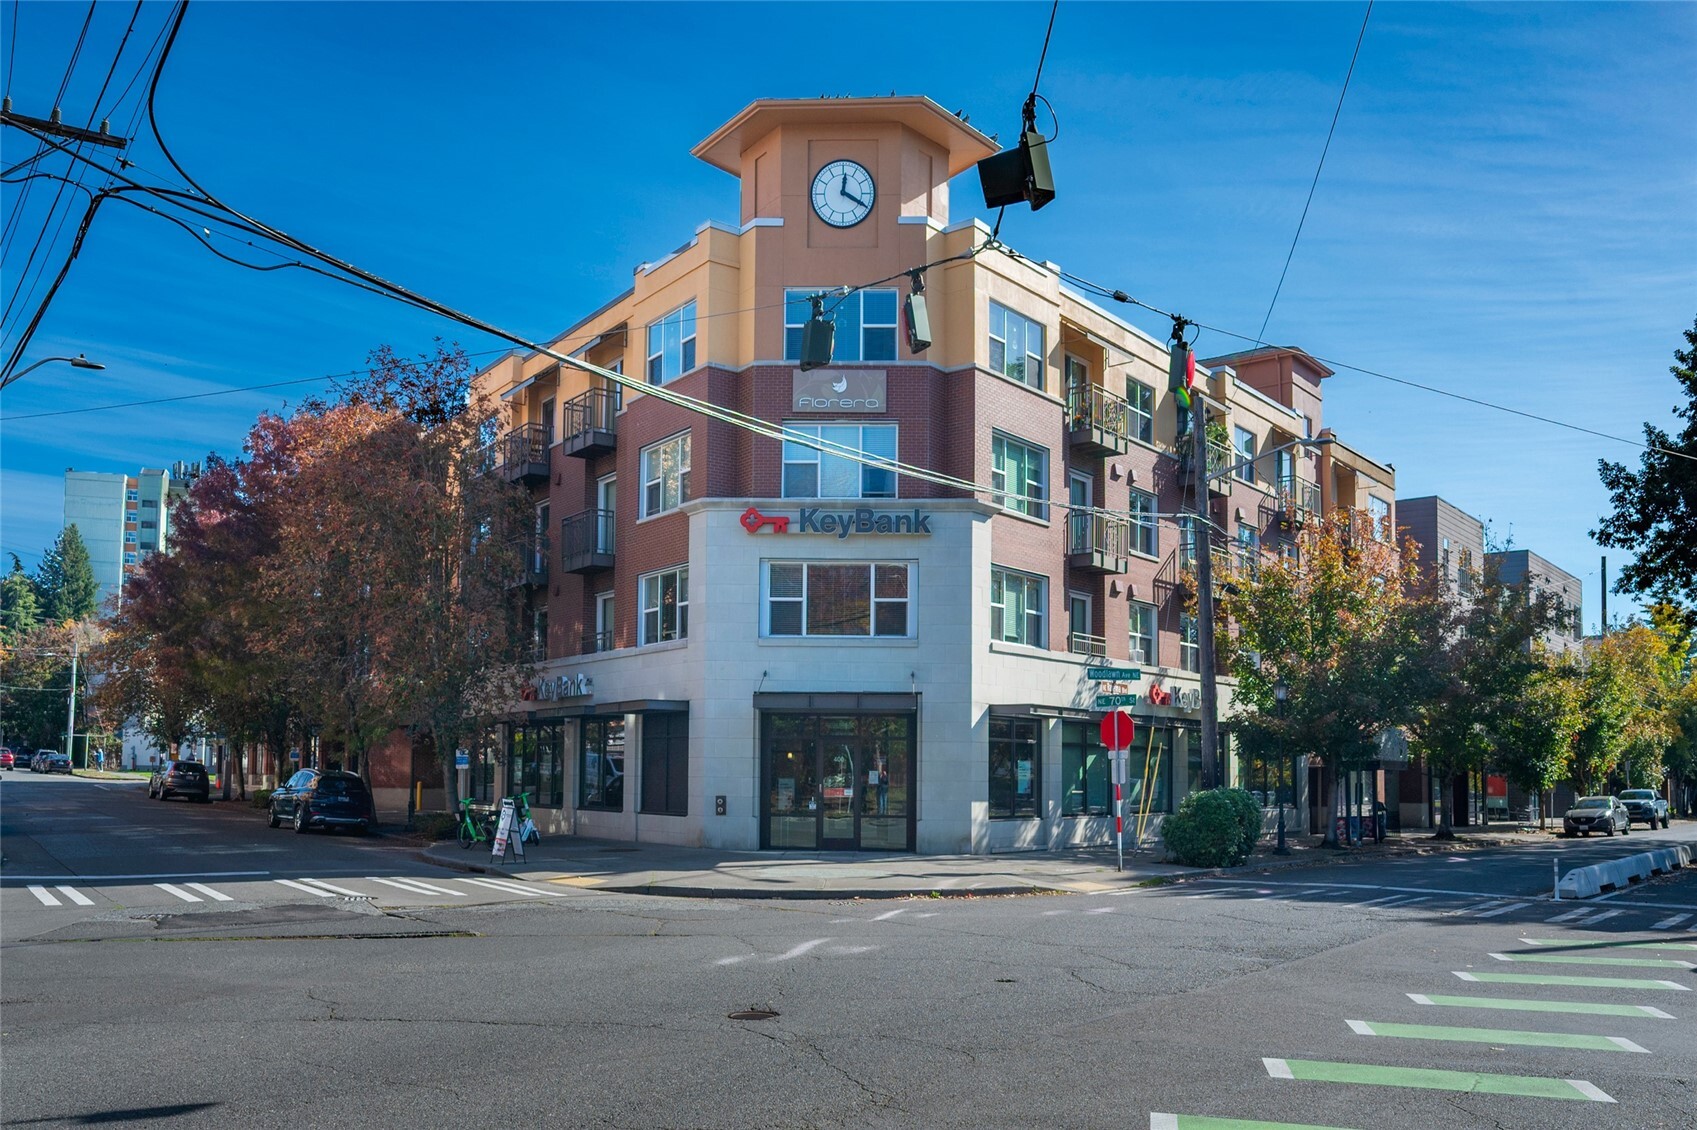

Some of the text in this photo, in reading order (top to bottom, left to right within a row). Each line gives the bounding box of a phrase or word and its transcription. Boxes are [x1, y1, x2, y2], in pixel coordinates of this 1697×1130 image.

[799, 397, 879, 408] Florera
[800, 507, 931, 538] KeyBank
[539, 673, 585, 701] KeyBank
[1089, 669, 1120, 679] Woodlawn
[1121, 671, 1131, 679] Ave
[1171, 685, 1201, 713] KeyB
